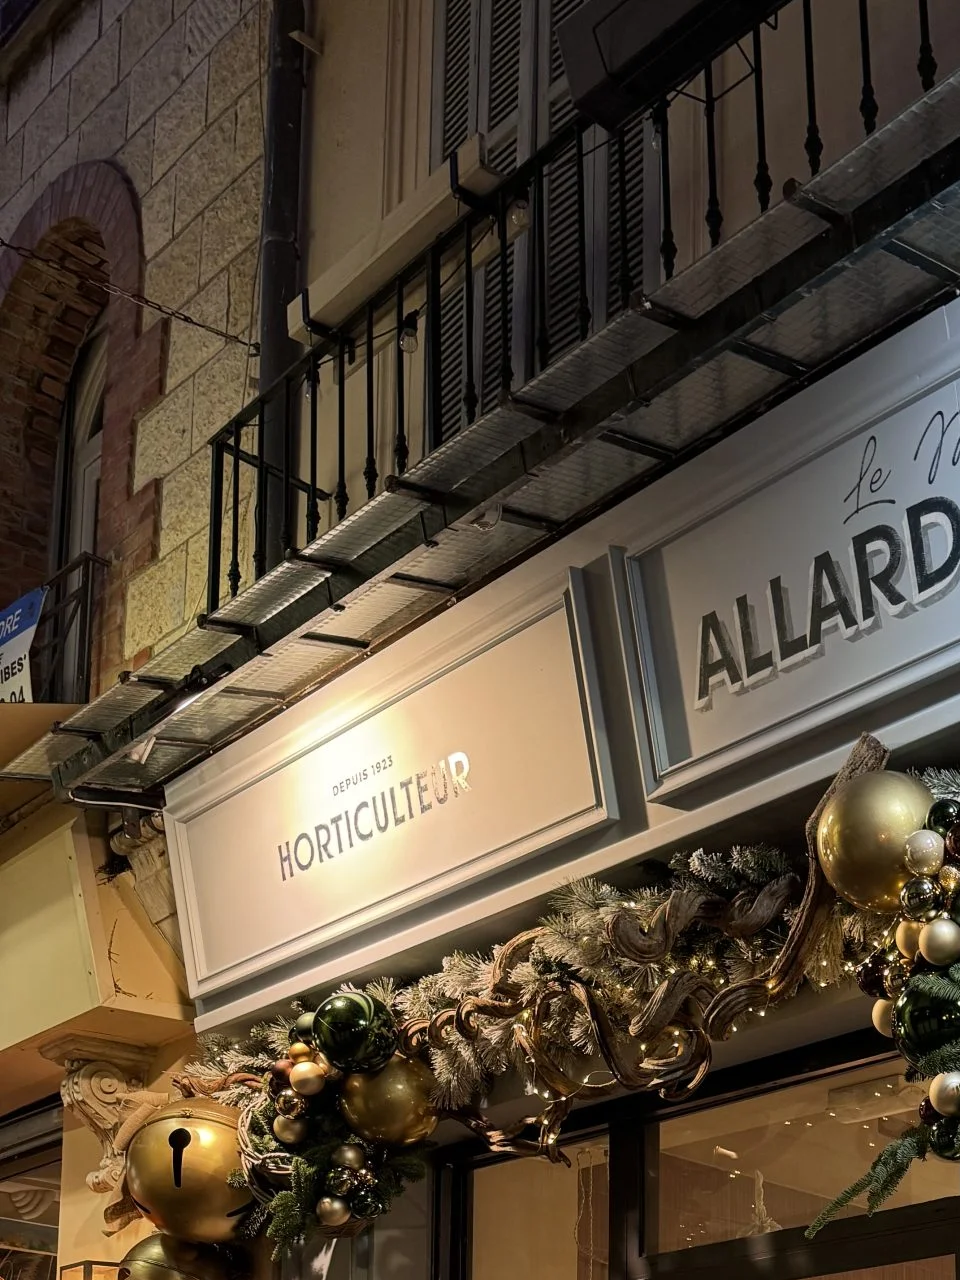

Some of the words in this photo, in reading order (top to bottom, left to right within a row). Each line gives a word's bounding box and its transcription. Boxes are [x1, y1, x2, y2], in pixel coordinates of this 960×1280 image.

[843, 436, 896, 523] Le
[277, 751, 472, 882] HORTICULTEUR
[332, 769, 369, 797] DEPUIS
[371, 755, 394, 776] 1923
